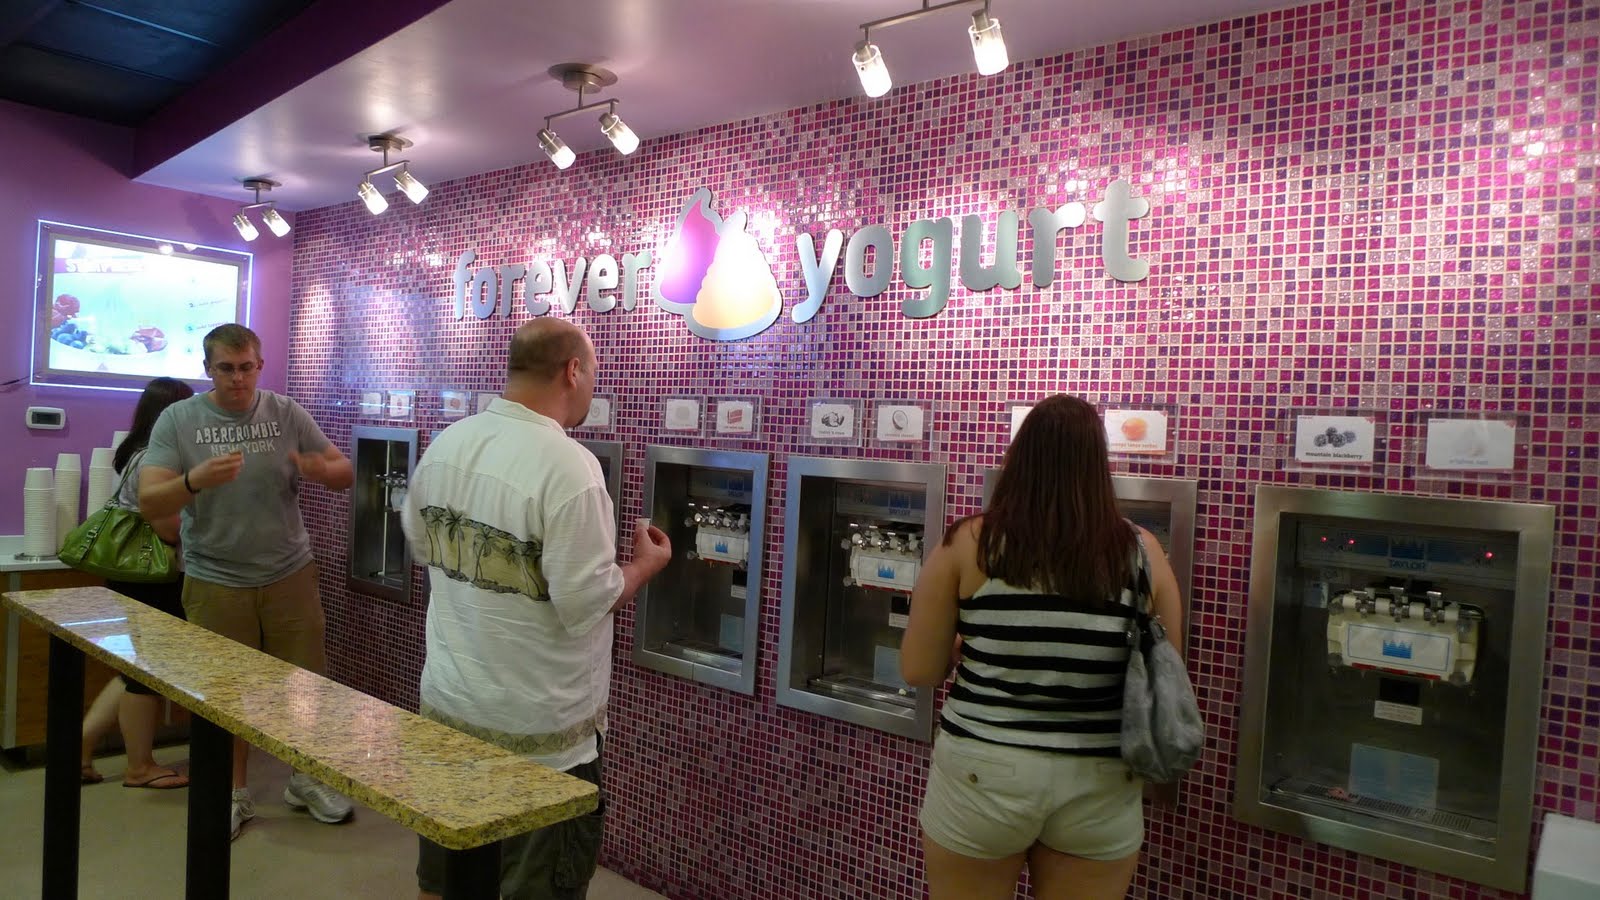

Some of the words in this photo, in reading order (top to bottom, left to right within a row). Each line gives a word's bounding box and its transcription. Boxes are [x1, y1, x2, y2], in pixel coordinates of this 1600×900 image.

[454, 249, 651, 321] forever
[791, 179, 1149, 323] yogurt
[195, 421, 281, 444] ABERCROMBIE
[211, 444, 239, 456] NEW
[243, 440, 275, 454] YORK
[1389, 559, 1426, 570] TAYLOR
